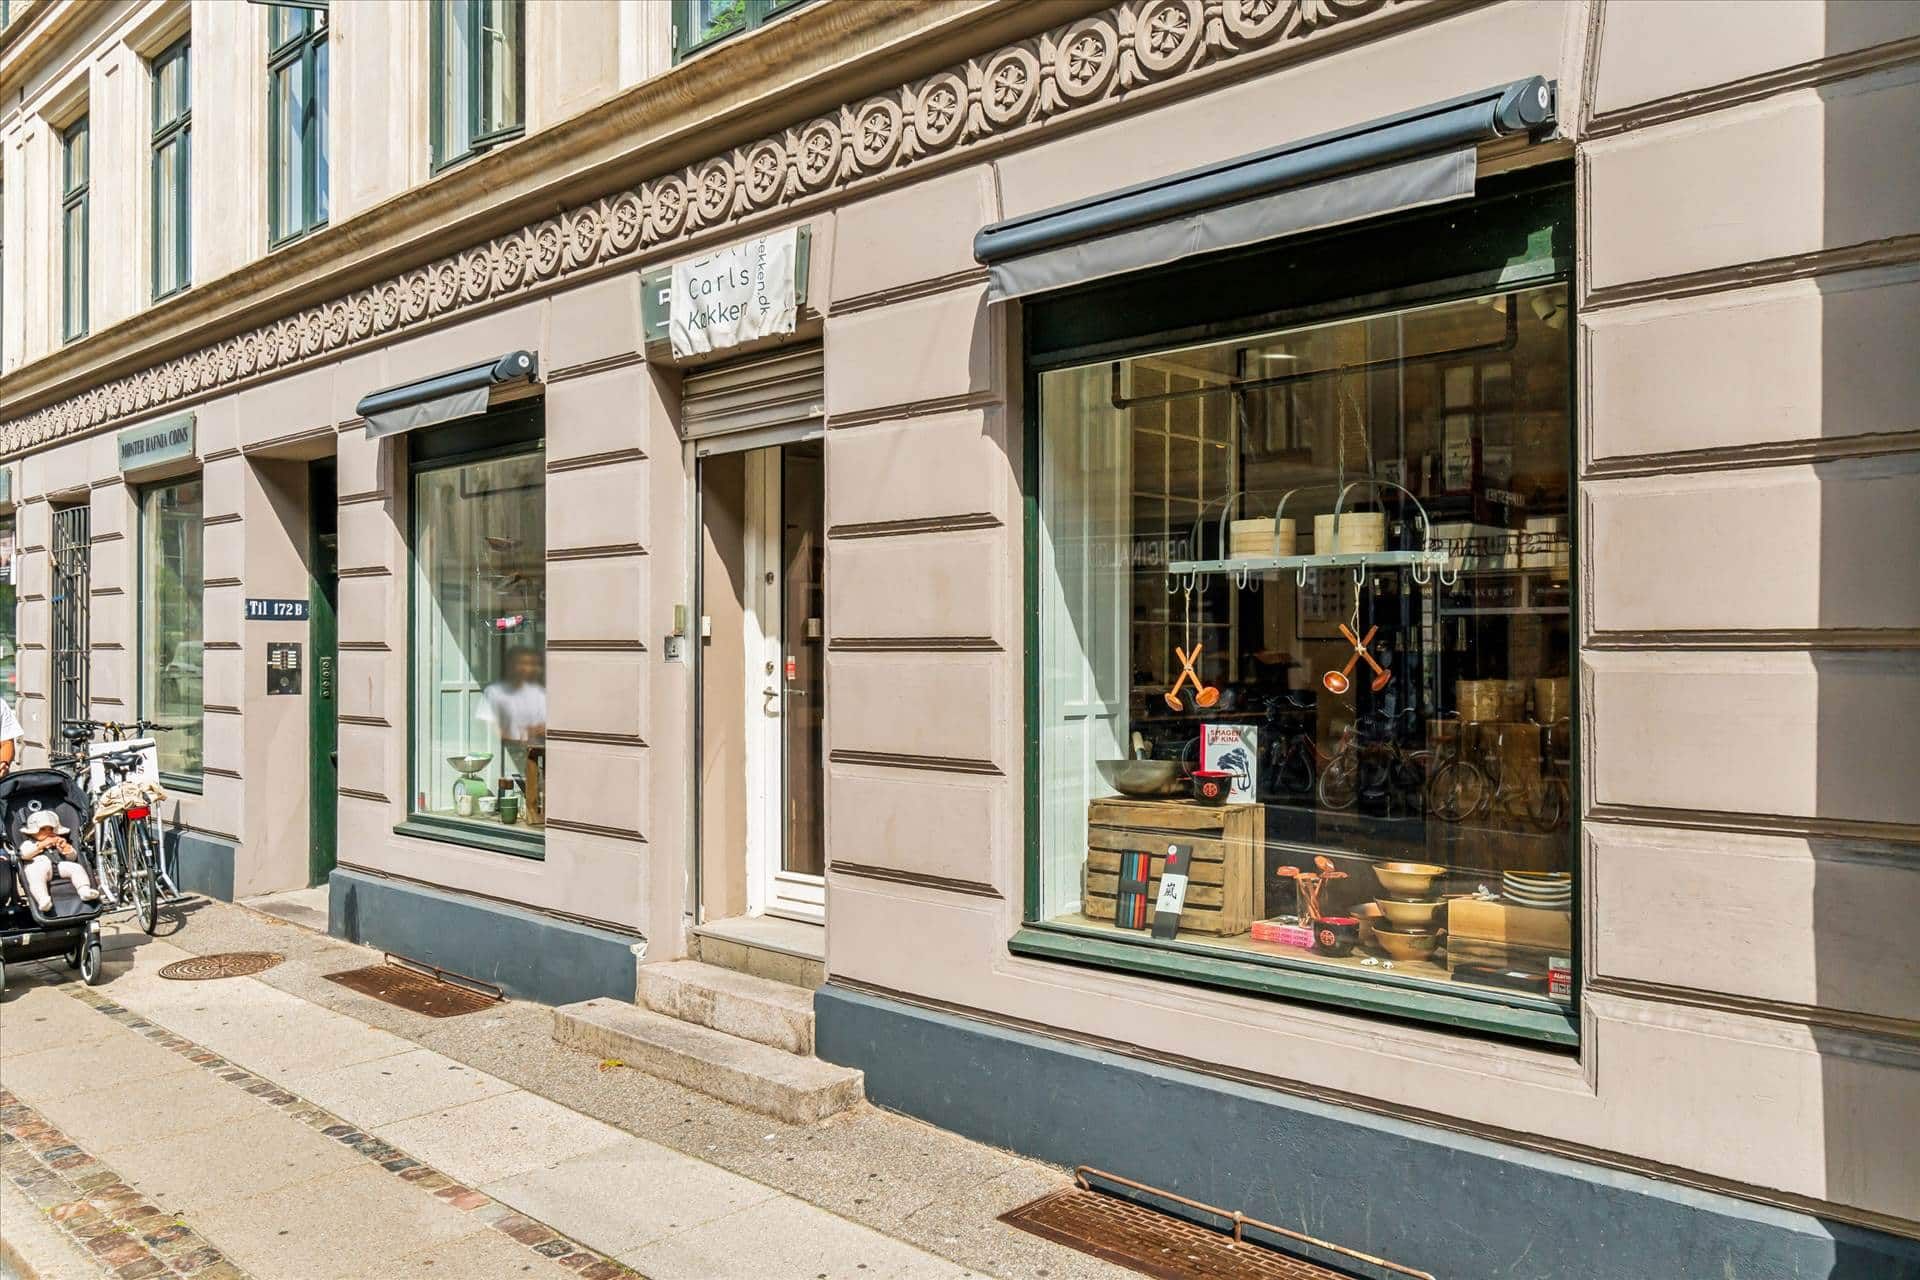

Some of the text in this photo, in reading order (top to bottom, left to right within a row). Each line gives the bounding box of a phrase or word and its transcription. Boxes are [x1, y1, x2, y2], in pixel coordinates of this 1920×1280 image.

[688, 267, 750, 300] Carls
[688, 302, 748, 331] Køkken
[249, 600, 267, 616] Til
